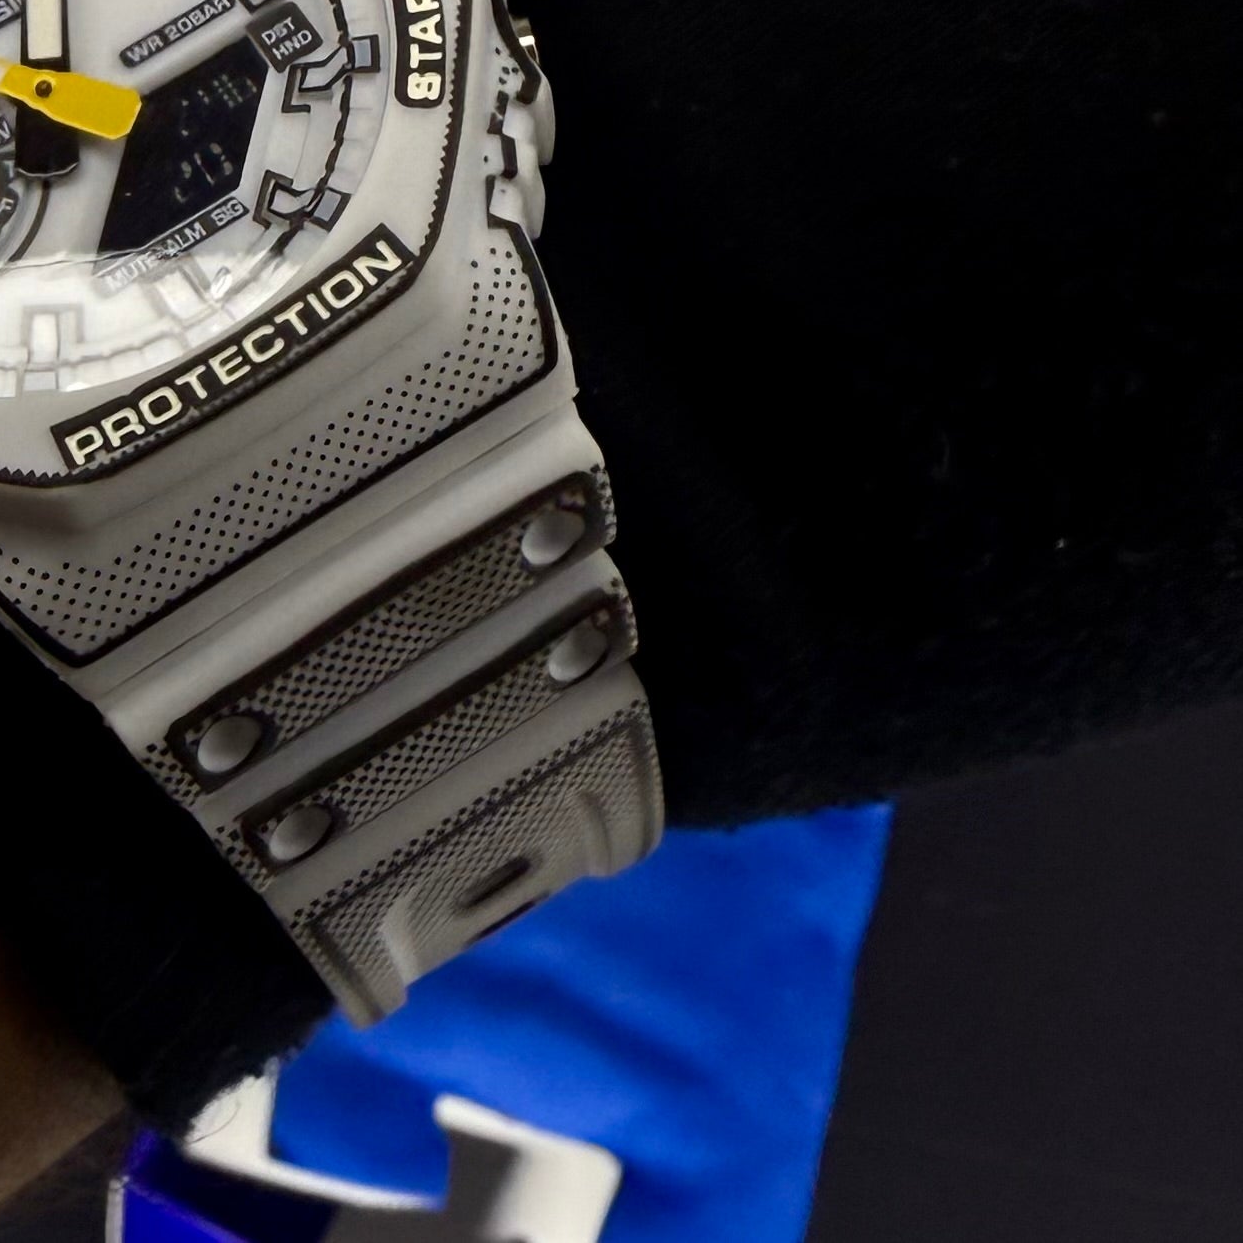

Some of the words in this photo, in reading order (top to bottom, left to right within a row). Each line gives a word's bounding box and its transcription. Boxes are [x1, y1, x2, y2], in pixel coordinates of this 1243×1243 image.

[126, 33, 165, 63] WR
[271, 29, 313, 61] HND
[63, 239, 403, 466] PROTECTION
